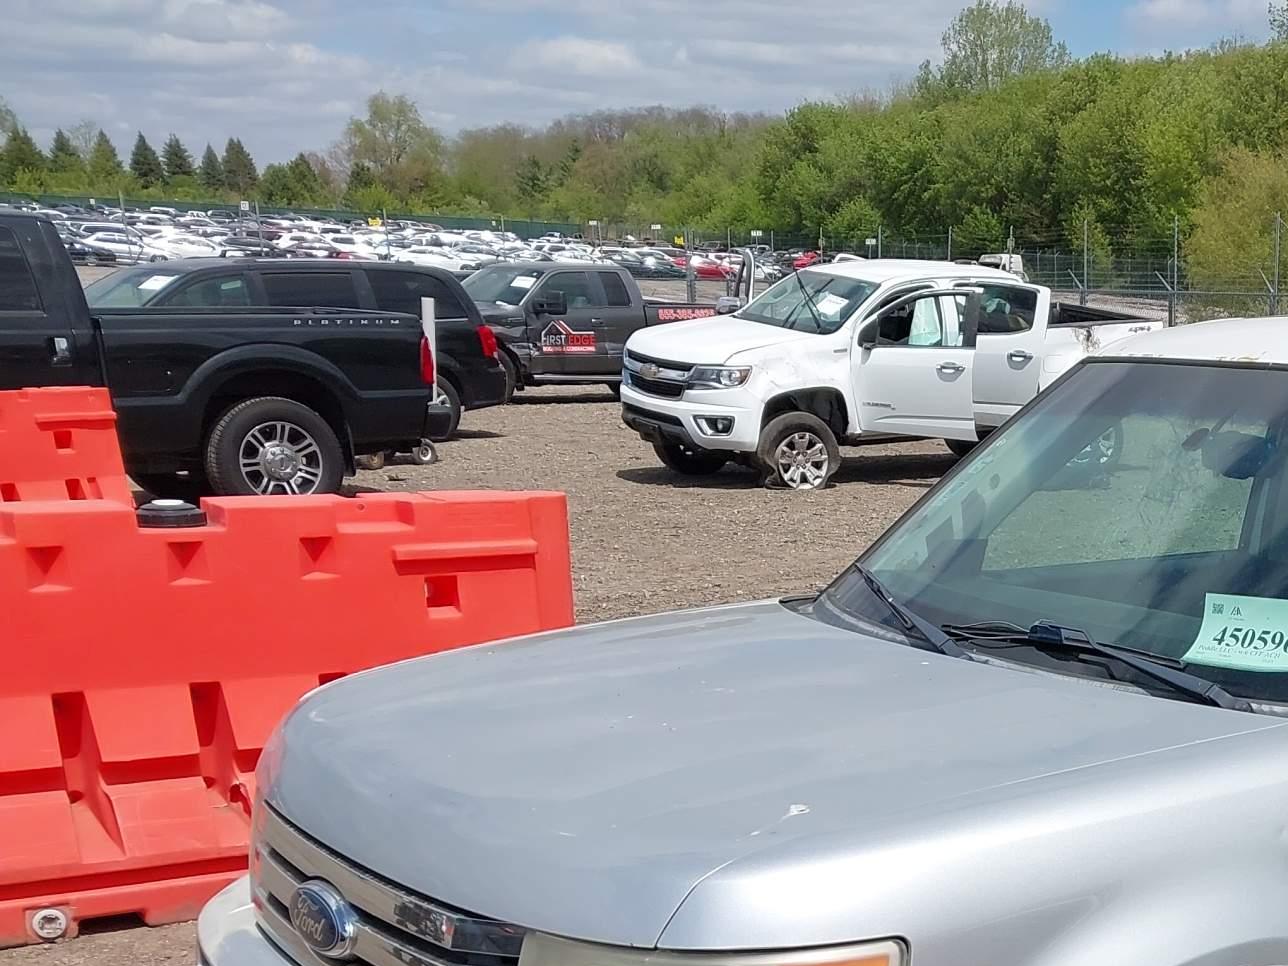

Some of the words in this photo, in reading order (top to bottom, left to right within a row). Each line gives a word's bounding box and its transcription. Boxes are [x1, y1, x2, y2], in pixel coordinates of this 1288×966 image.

[541, 335, 567, 346] FIRST
[568, 335, 596, 346] EDGE
[293, 894, 326, 942] Ford
